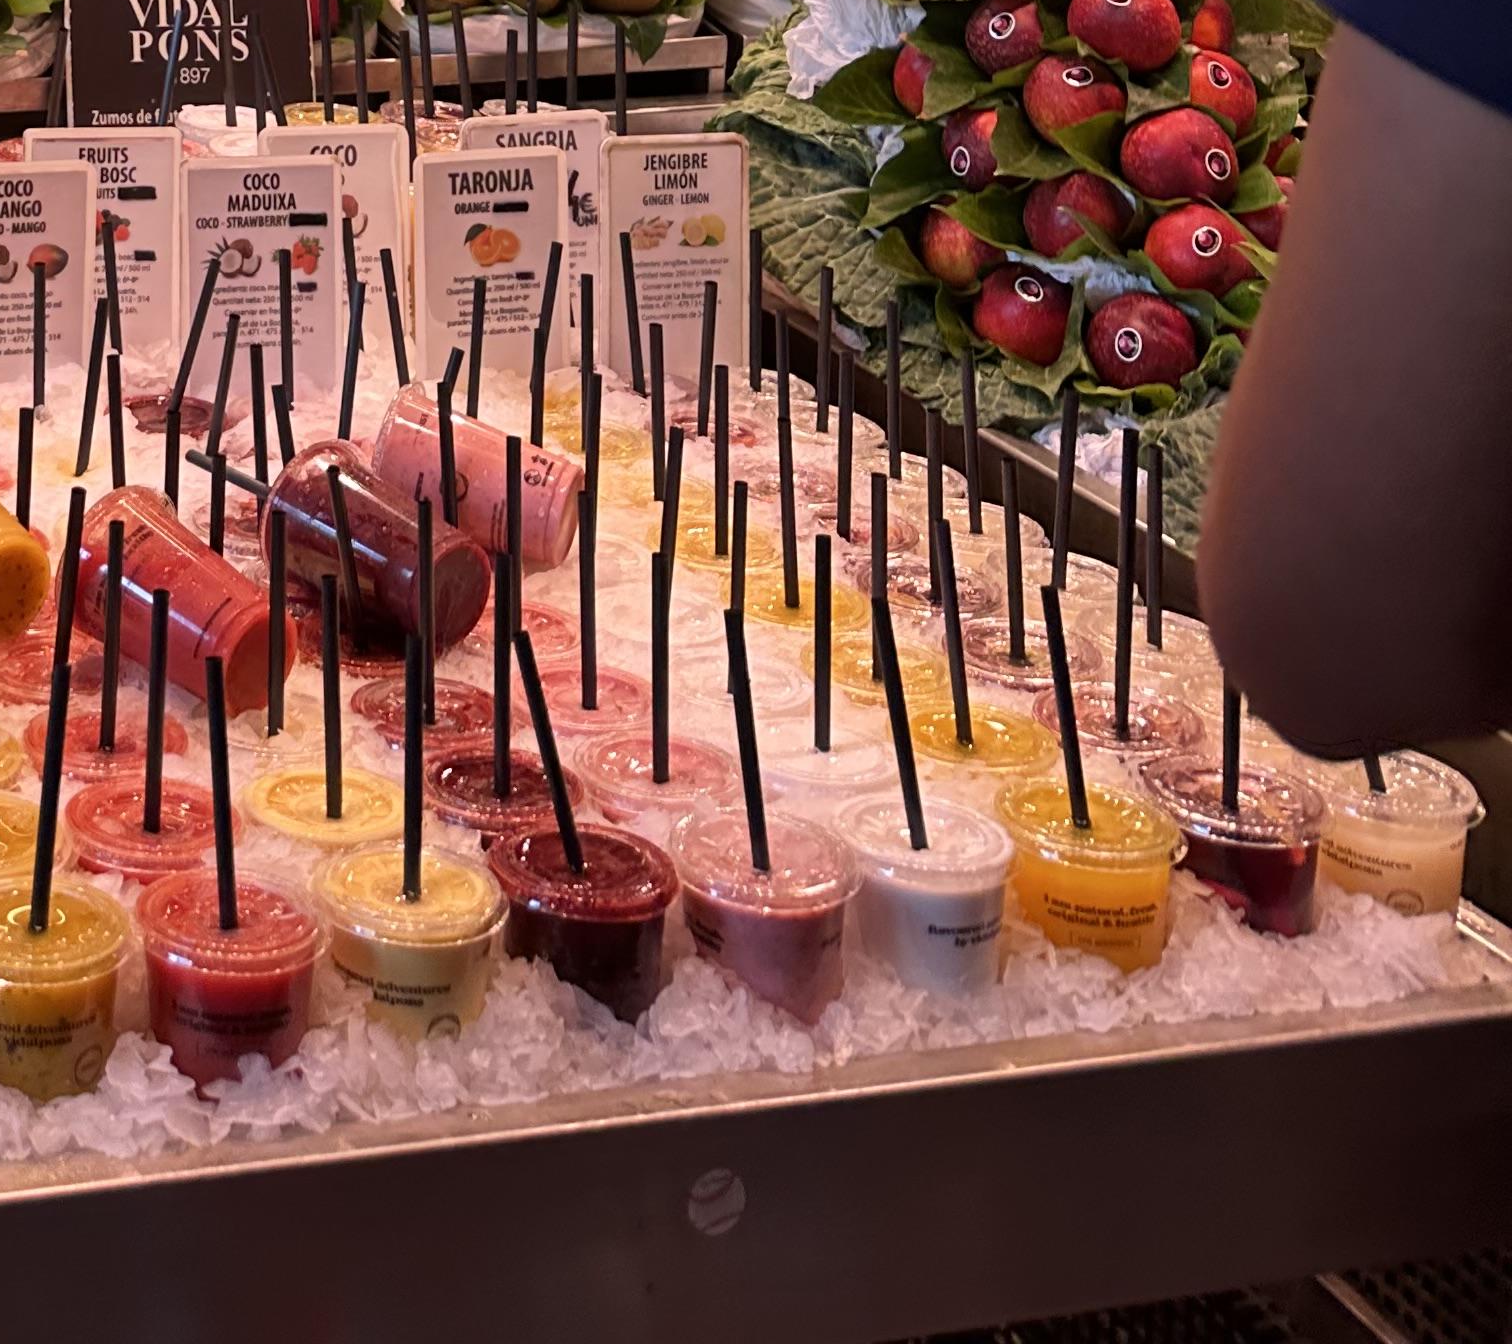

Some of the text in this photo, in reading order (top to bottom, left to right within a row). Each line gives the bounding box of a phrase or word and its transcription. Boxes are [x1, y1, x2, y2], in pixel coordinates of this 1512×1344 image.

[129, 29, 249, 63] PONS
[175, 67, 210, 84] 897
[92, 110, 134, 125] Zumos
[136, 108, 152, 124] de
[495, 129, 578, 151] SANGRIA
[79, 147, 129, 164] FRUITS
[643, 152, 708, 171] JENGIBRE
[100, 167, 137, 184] BOSC
[243, 173, 280, 191] COCO
[448, 168, 534, 195] TARONJA
[654, 169, 699, 190] LIMÓN
[96, 188, 116, 200] UITS
[227, 192, 297, 212] MADUIXA
[642, 192, 710, 206] GINGER LEMON
[454, 201, 490, 215] ORANGE
[11, 221, 47, 234] MANGO
[196, 215, 287, 229] COCO STRAWBERRY
